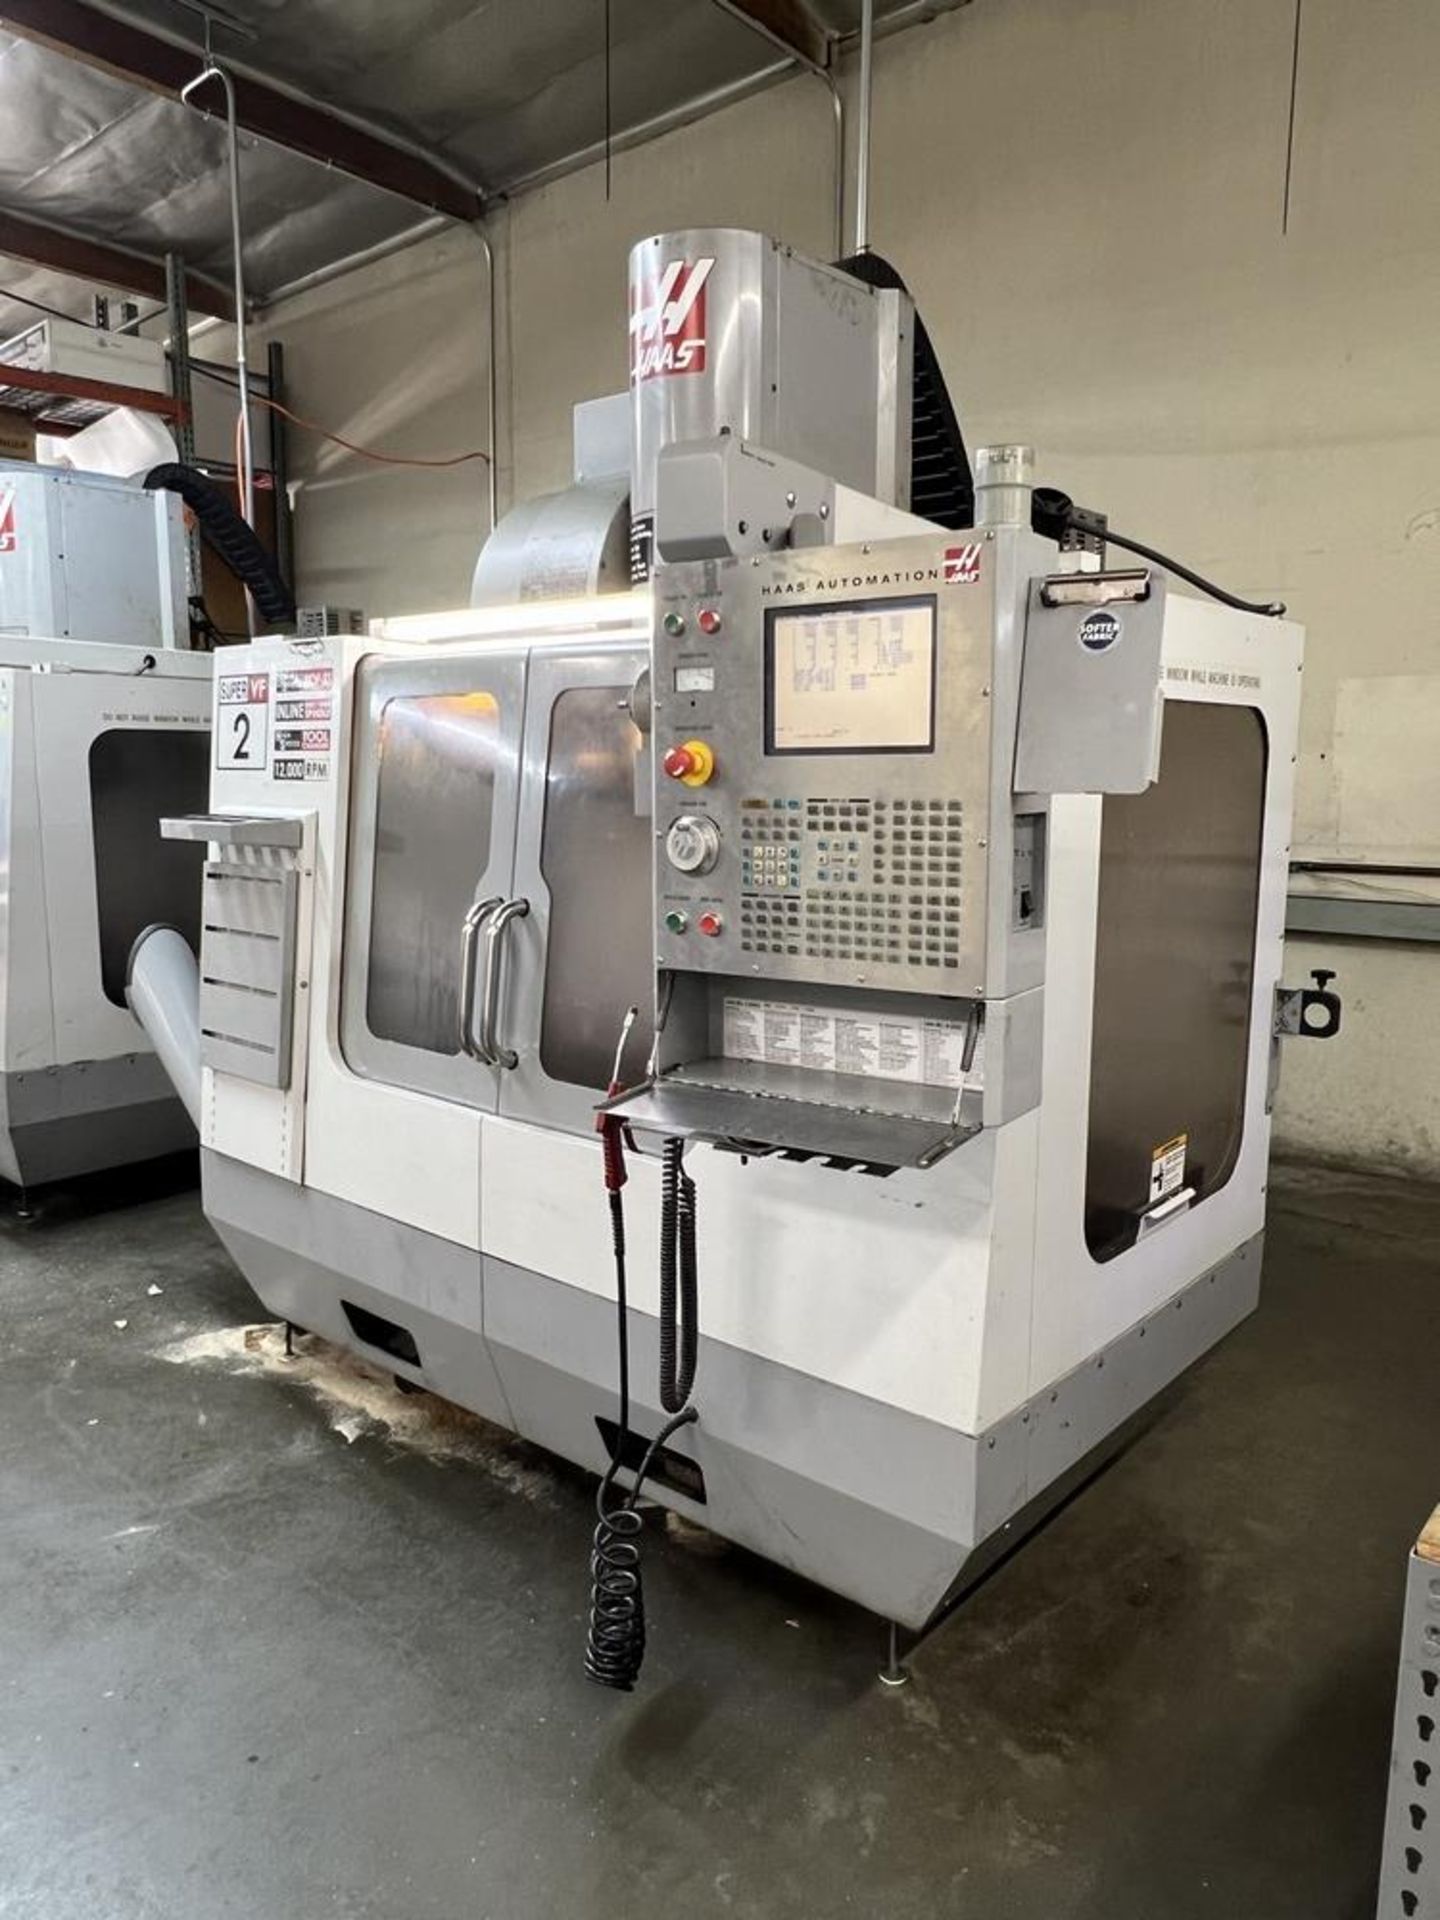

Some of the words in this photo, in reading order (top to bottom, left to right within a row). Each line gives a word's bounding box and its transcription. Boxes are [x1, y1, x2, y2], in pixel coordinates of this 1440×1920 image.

[762, 583, 807, 596] HAAS
[816, 569, 939, 591] AUTOMATION
[220, 680, 247, 700] SUPER
[249, 679, 267, 699] VF
[233, 711, 250, 760] 2
